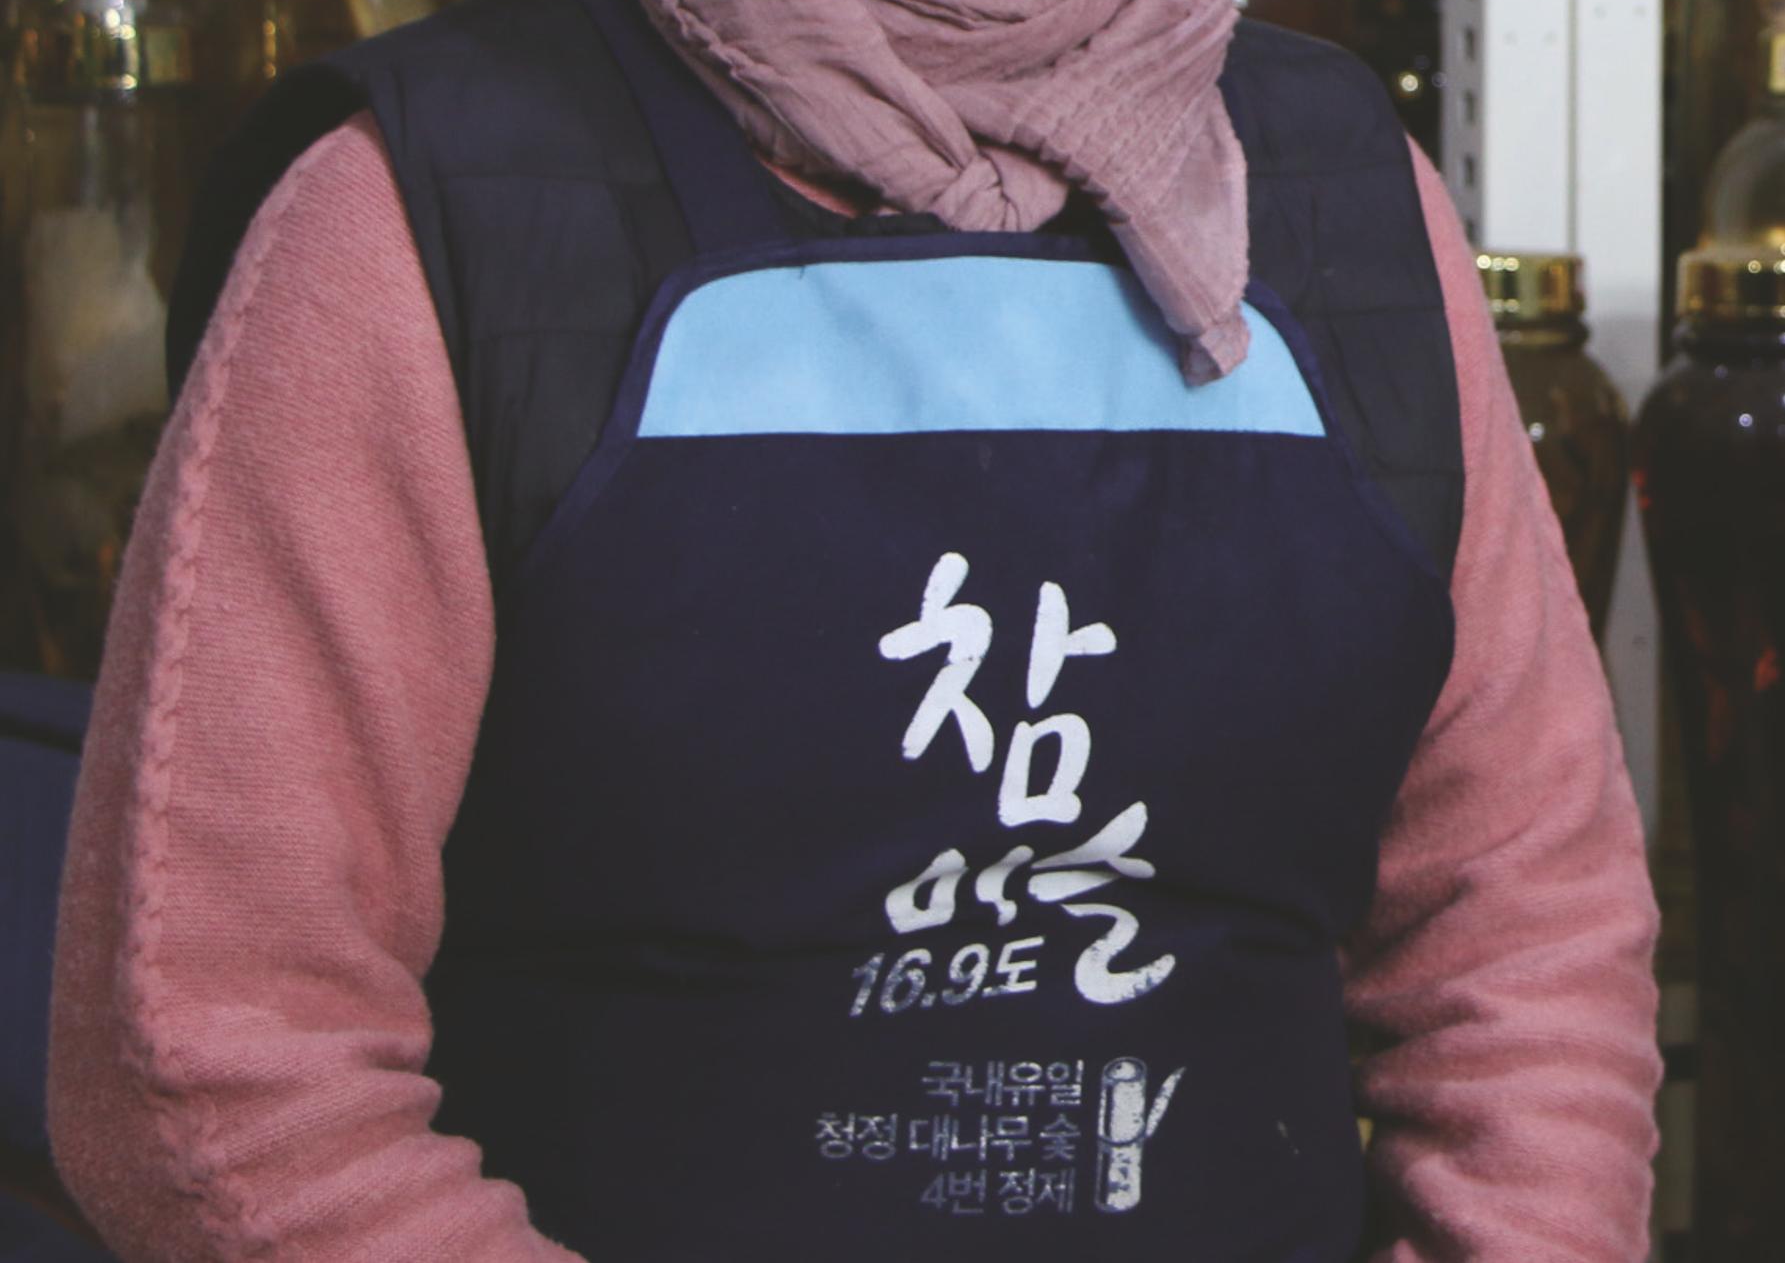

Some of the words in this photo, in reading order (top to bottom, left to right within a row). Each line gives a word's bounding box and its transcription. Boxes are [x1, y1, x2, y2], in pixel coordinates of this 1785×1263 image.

[878, 552, 1118, 827] 참
[849, 936, 1046, 1017] 16.9도
[921, 1059, 1084, 1107] 국내유일
[815, 1112, 899, 1161] 청정
[909, 1114, 1033, 1162] 대나무
[1039, 1113, 1081, 1161] 숯
[920, 1168, 987, 1214] 4번
[999, 1168, 1076, 1215] 정제
